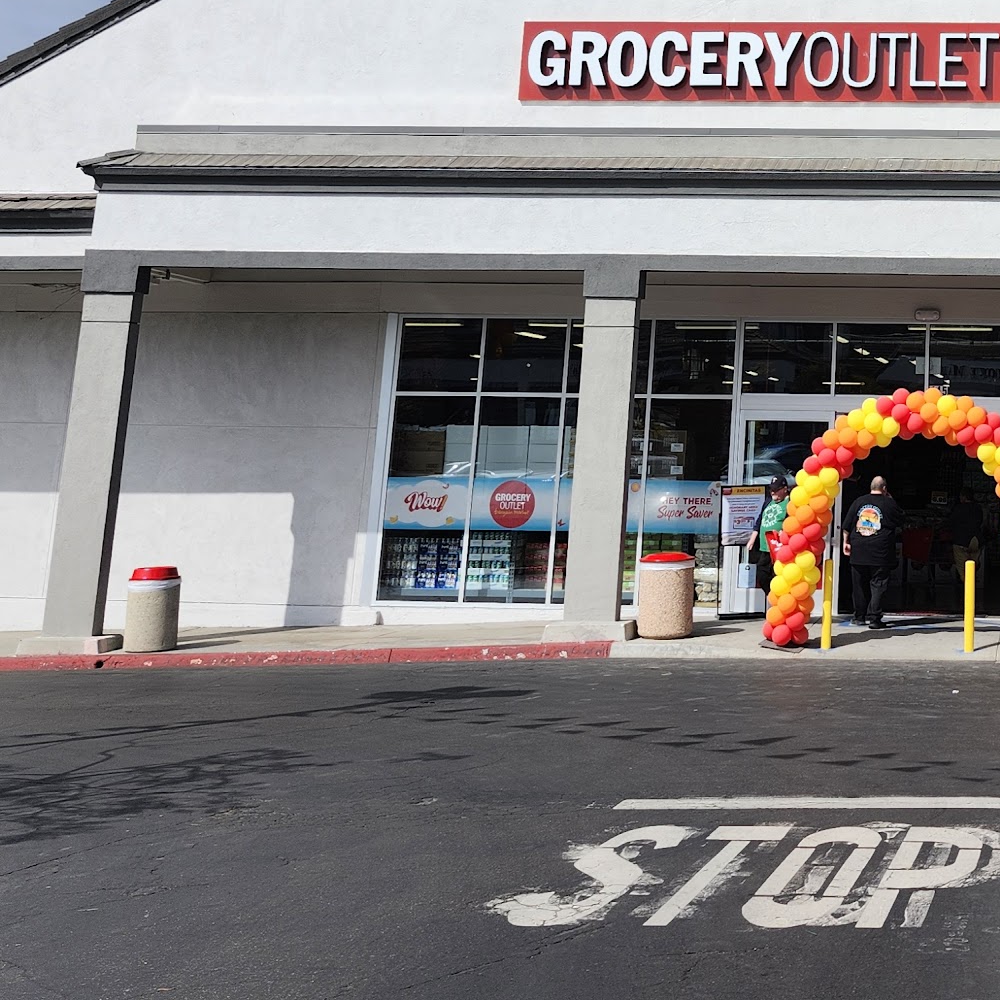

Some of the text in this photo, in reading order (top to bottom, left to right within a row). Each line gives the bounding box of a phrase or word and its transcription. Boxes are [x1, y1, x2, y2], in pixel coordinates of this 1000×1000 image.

[404, 491, 448, 512] Wow!
[495, 493, 531, 502] GROCERY
[500, 501, 525, 510] OUTLET
[657, 505, 713, 521] Super Saver
